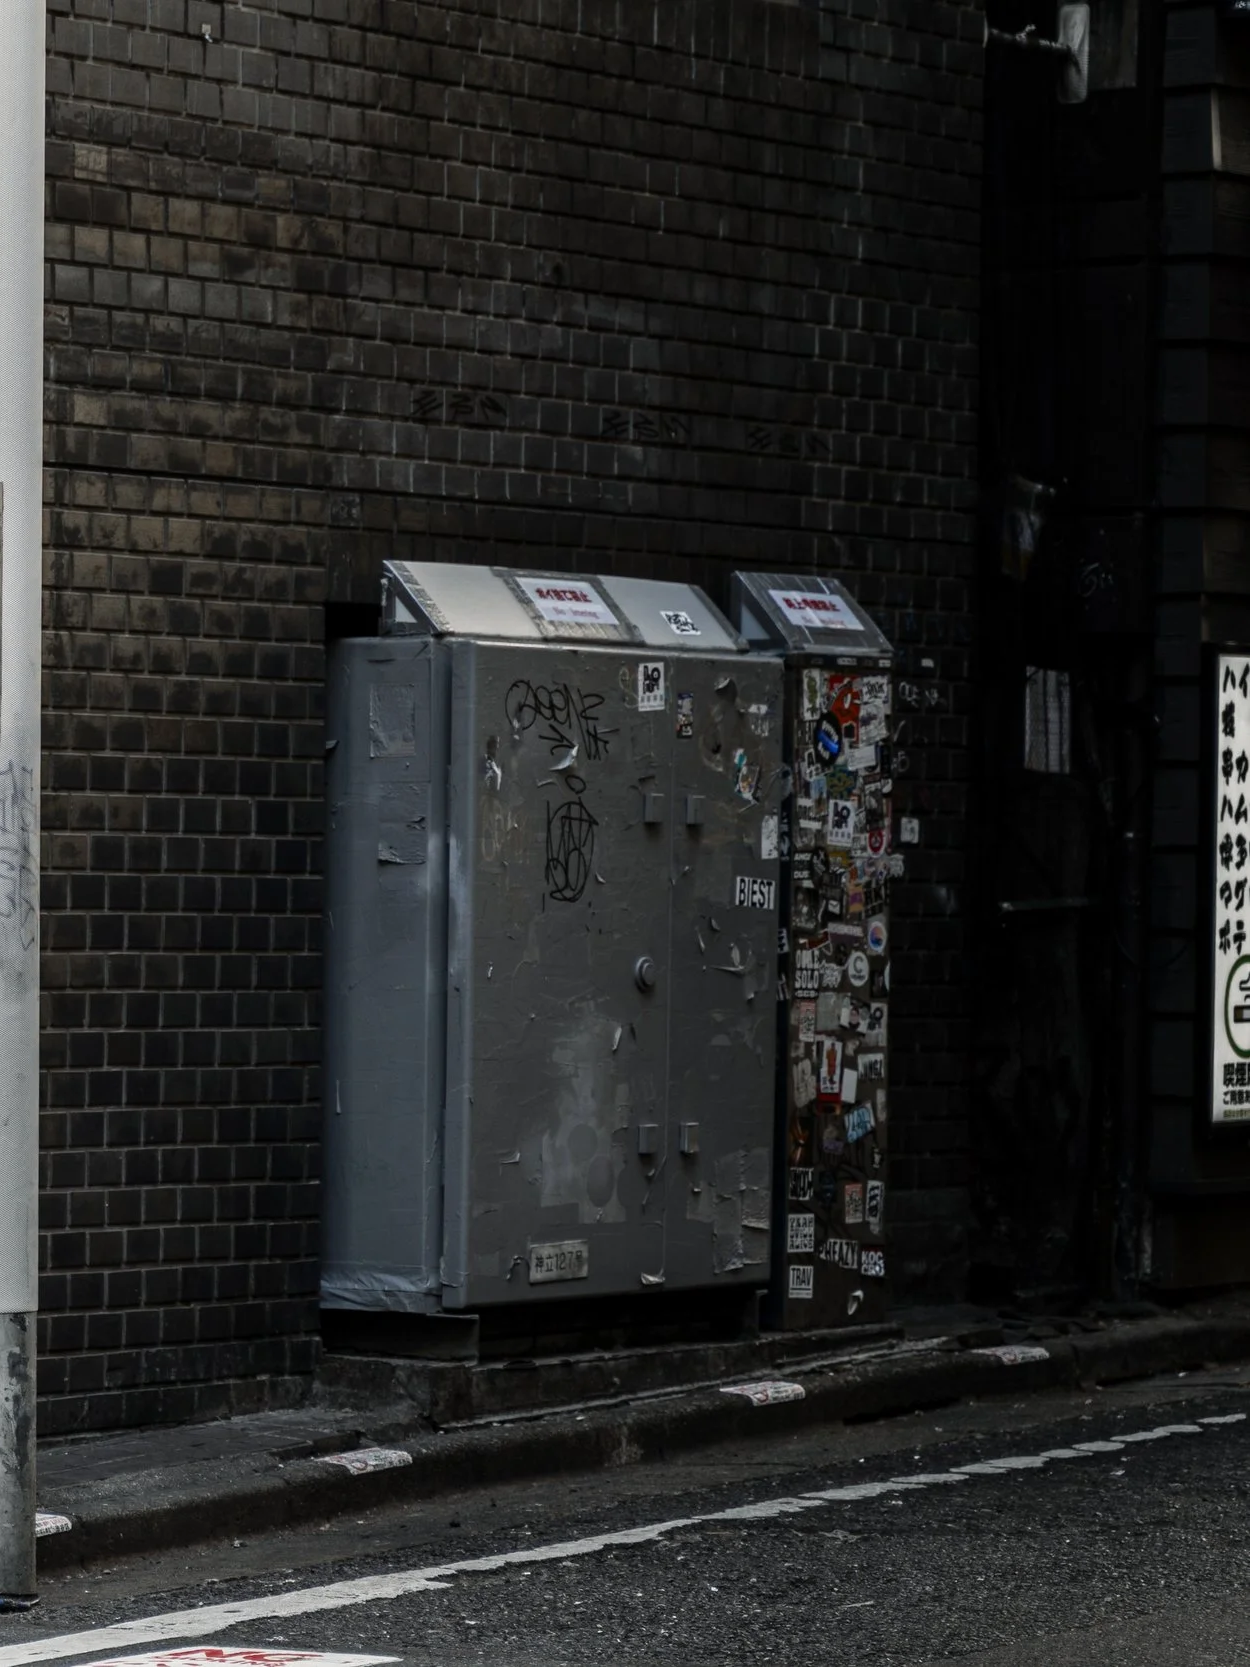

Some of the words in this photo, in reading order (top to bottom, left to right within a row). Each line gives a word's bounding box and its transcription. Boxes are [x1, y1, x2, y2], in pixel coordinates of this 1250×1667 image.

[739, 878, 772, 908] BIEST
[1223, 1062, 1250, 1088] 喫煙
[791, 1267, 812, 1287] TRAV
